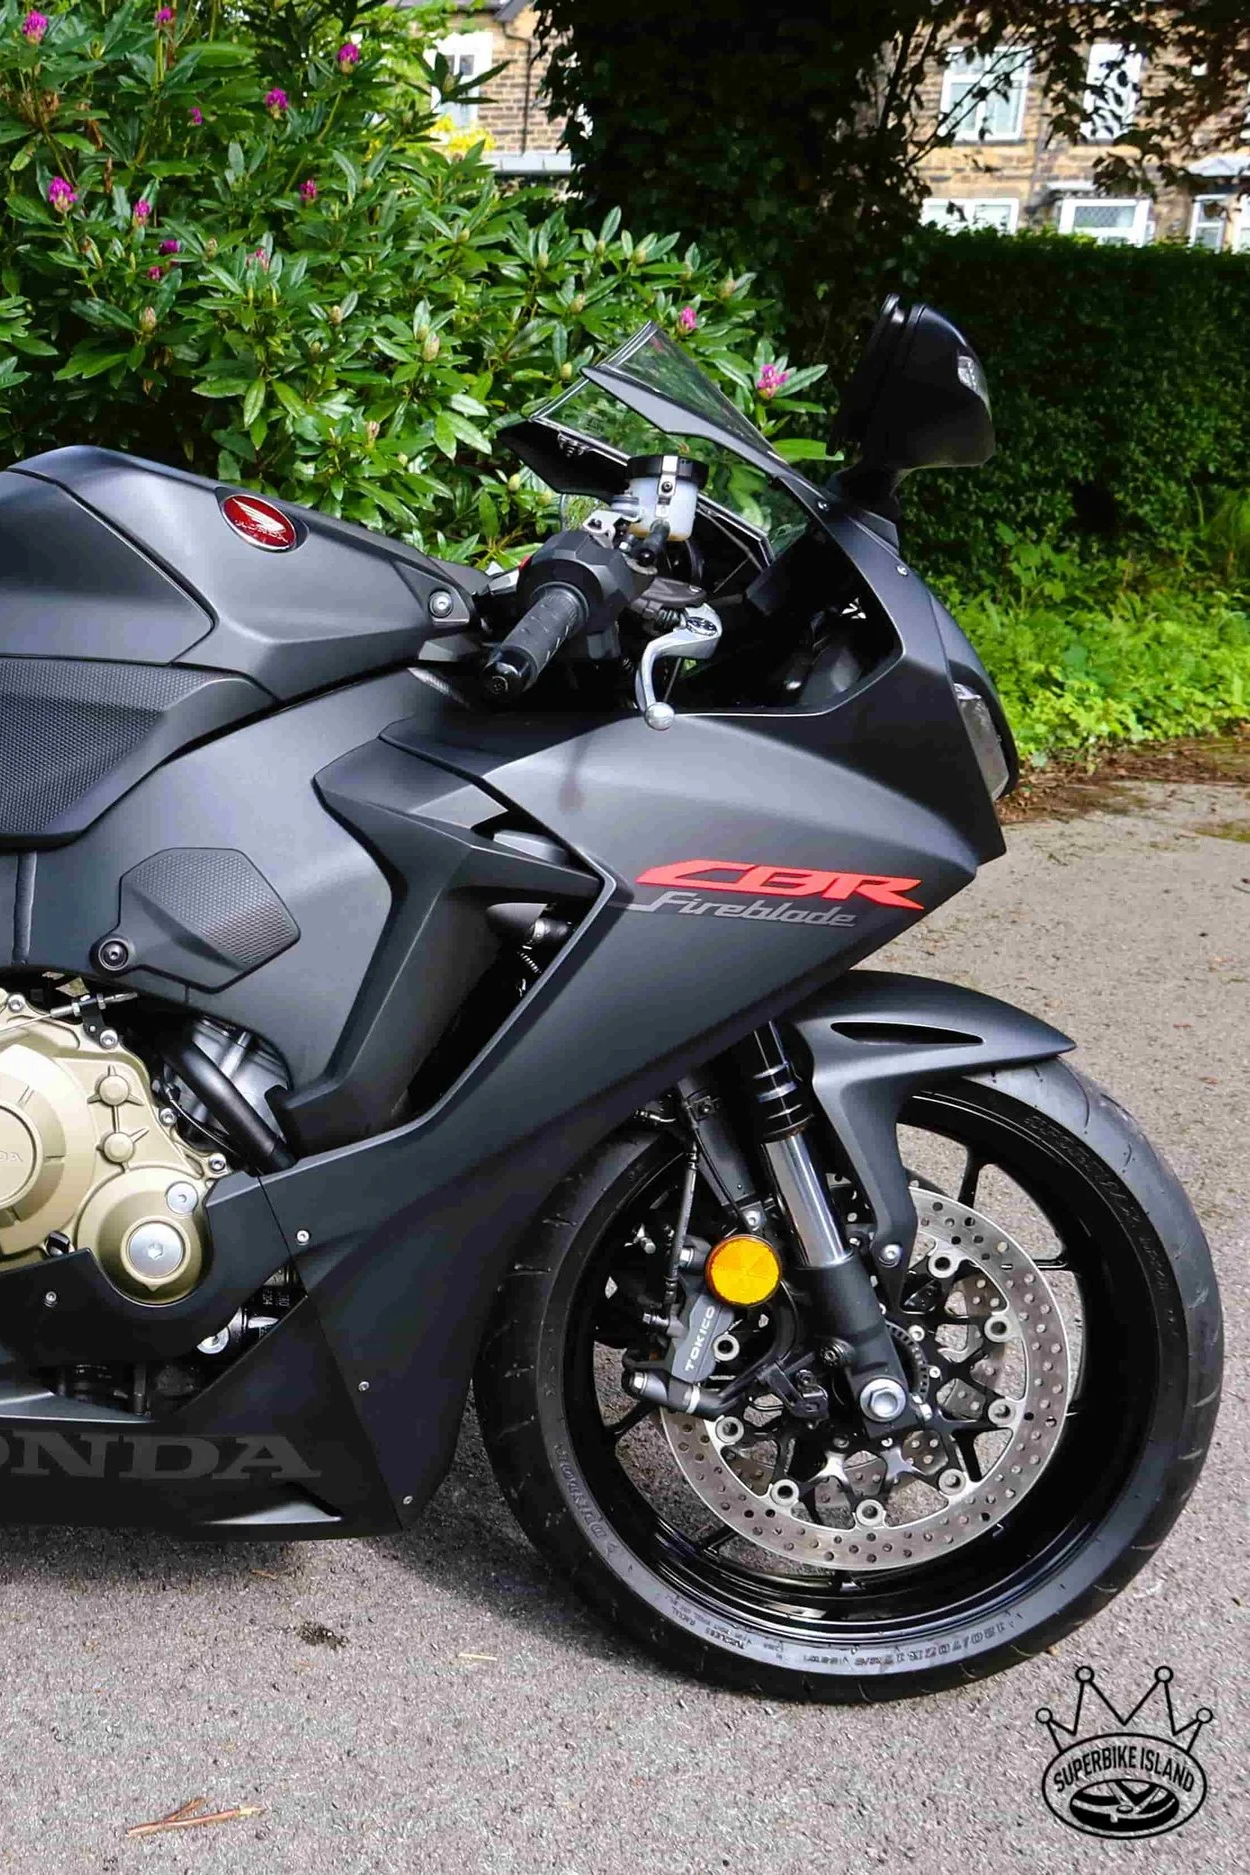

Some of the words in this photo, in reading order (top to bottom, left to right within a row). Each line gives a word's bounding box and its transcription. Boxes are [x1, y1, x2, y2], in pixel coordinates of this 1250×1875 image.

[628, 890, 856, 928] Fireblade
[635, 858, 925, 910] CBR
[684, 1304, 716, 1372] TOKICO
